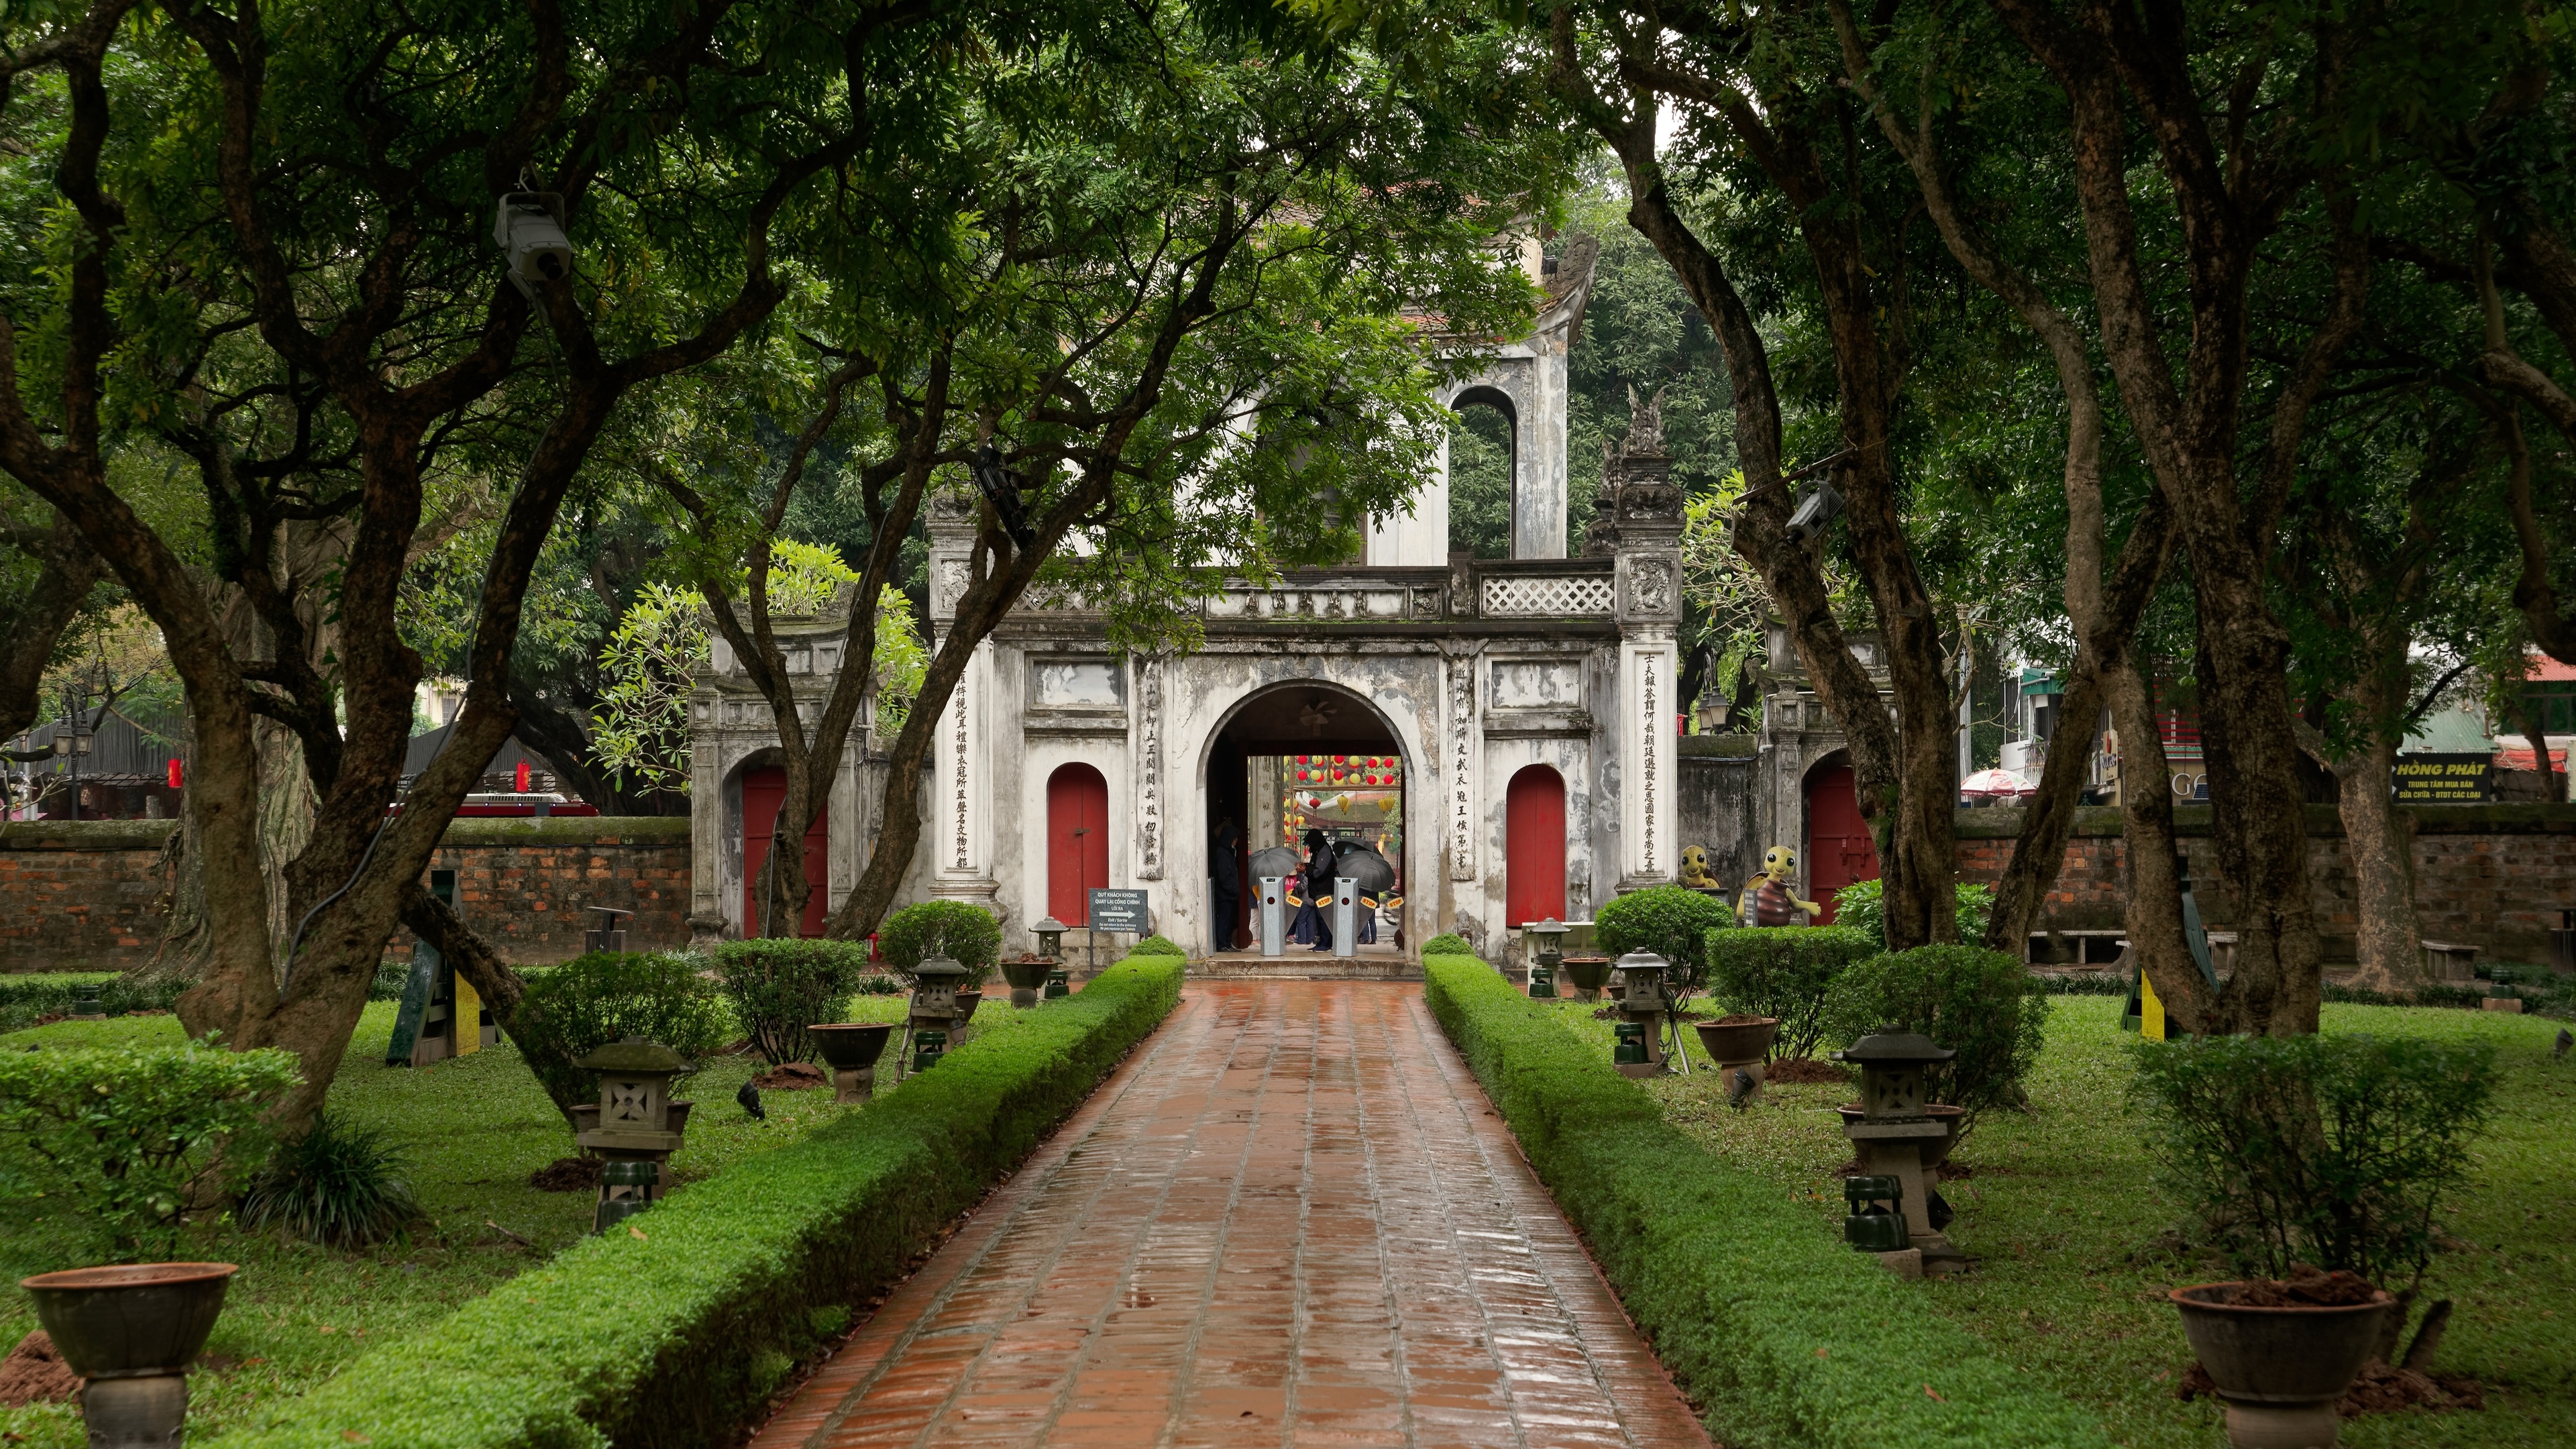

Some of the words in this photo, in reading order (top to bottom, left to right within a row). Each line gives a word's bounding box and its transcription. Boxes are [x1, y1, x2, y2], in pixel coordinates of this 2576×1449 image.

[2397, 759, 2443, 775] HỒNG
[2446, 761, 2486, 775] PHÁT
[2430, 780, 2443, 788] TÂM
[2460, 780, 2473, 788] BÁN
[2399, 790, 2412, 798] SỬA
[2453, 790, 2465, 798] CÁC
[2467, 791, 2481, 800] LOẠI
[1287, 897, 1301, 905] STOP
[1318, 898, 1330, 906] STOP
[1362, 898, 1375, 907] STOP
[1389, 899, 1401, 908] STOP
